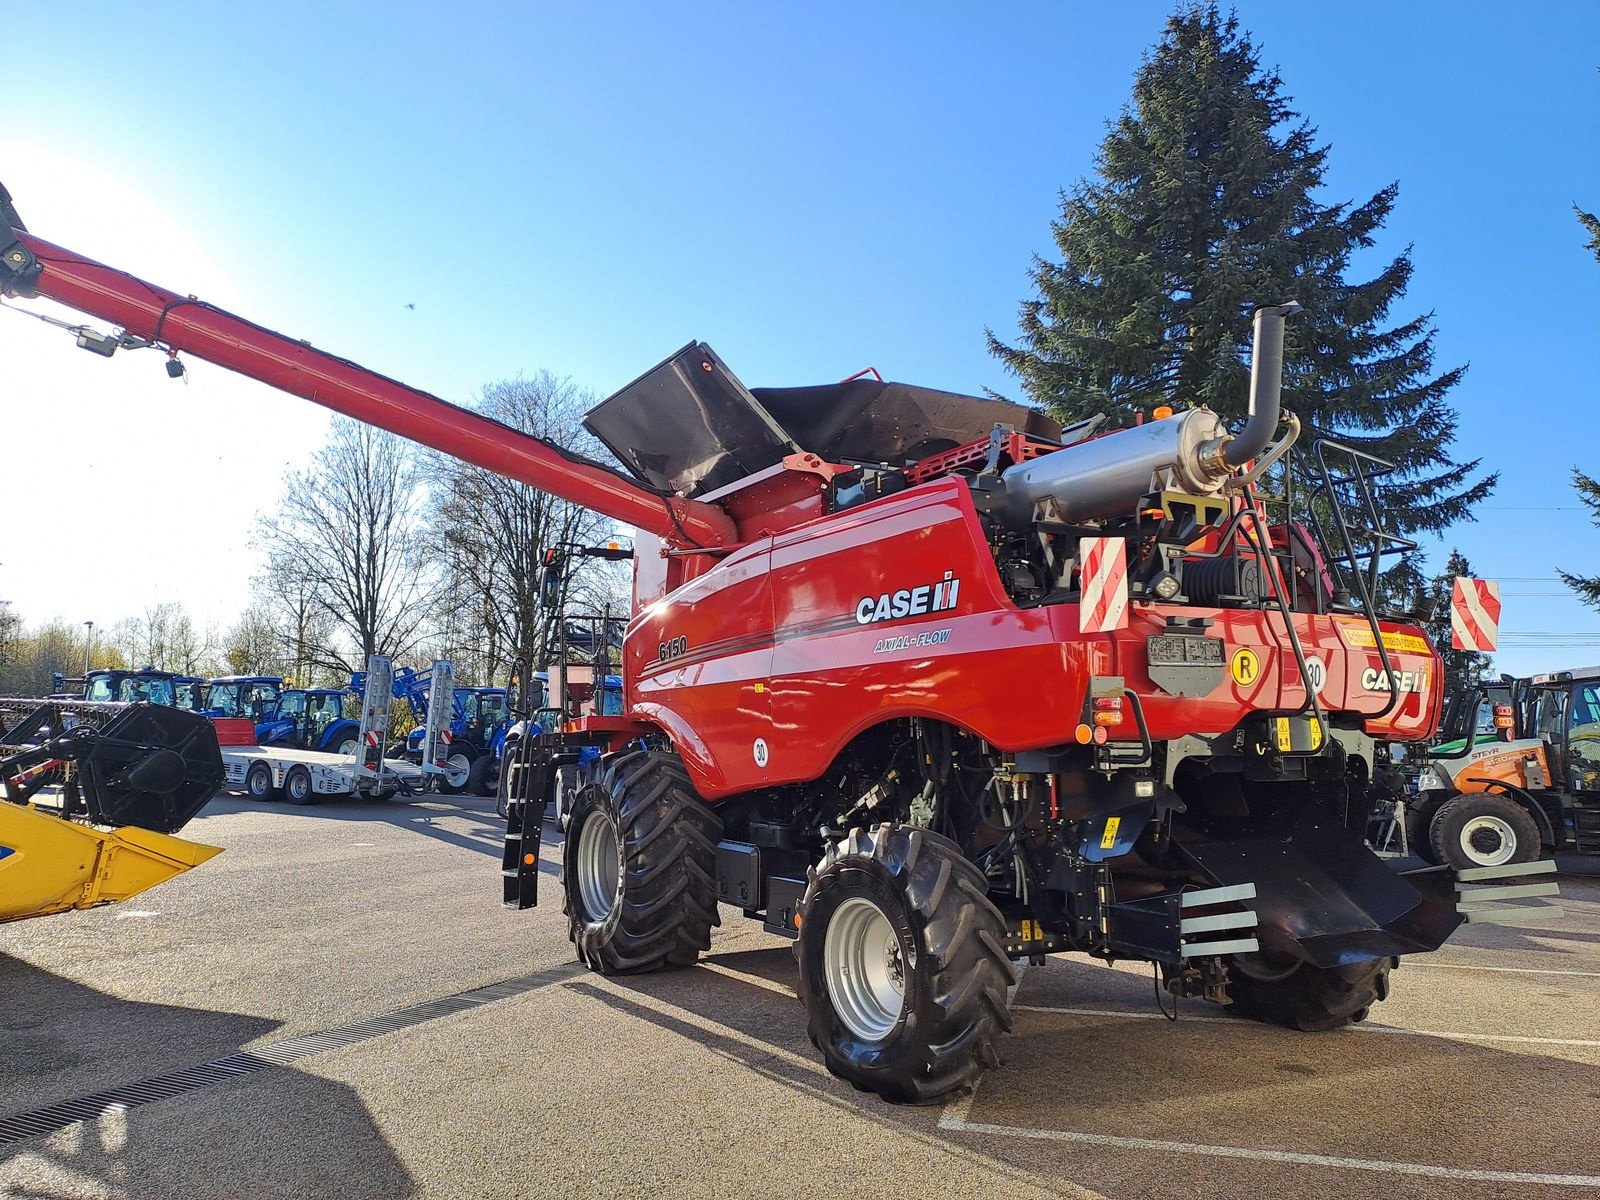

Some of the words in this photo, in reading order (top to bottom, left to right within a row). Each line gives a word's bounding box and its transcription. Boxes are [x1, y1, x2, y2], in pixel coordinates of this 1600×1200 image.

[856, 585, 930, 625] CASE
[659, 635, 687, 661] 6150
[1239, 656, 1251, 679] R
[1307, 663, 1321, 687] 30
[756, 743, 766, 761] 30
[1471, 747, 1500, 760] STEYR
[1485, 755, 1508, 768] 4130
